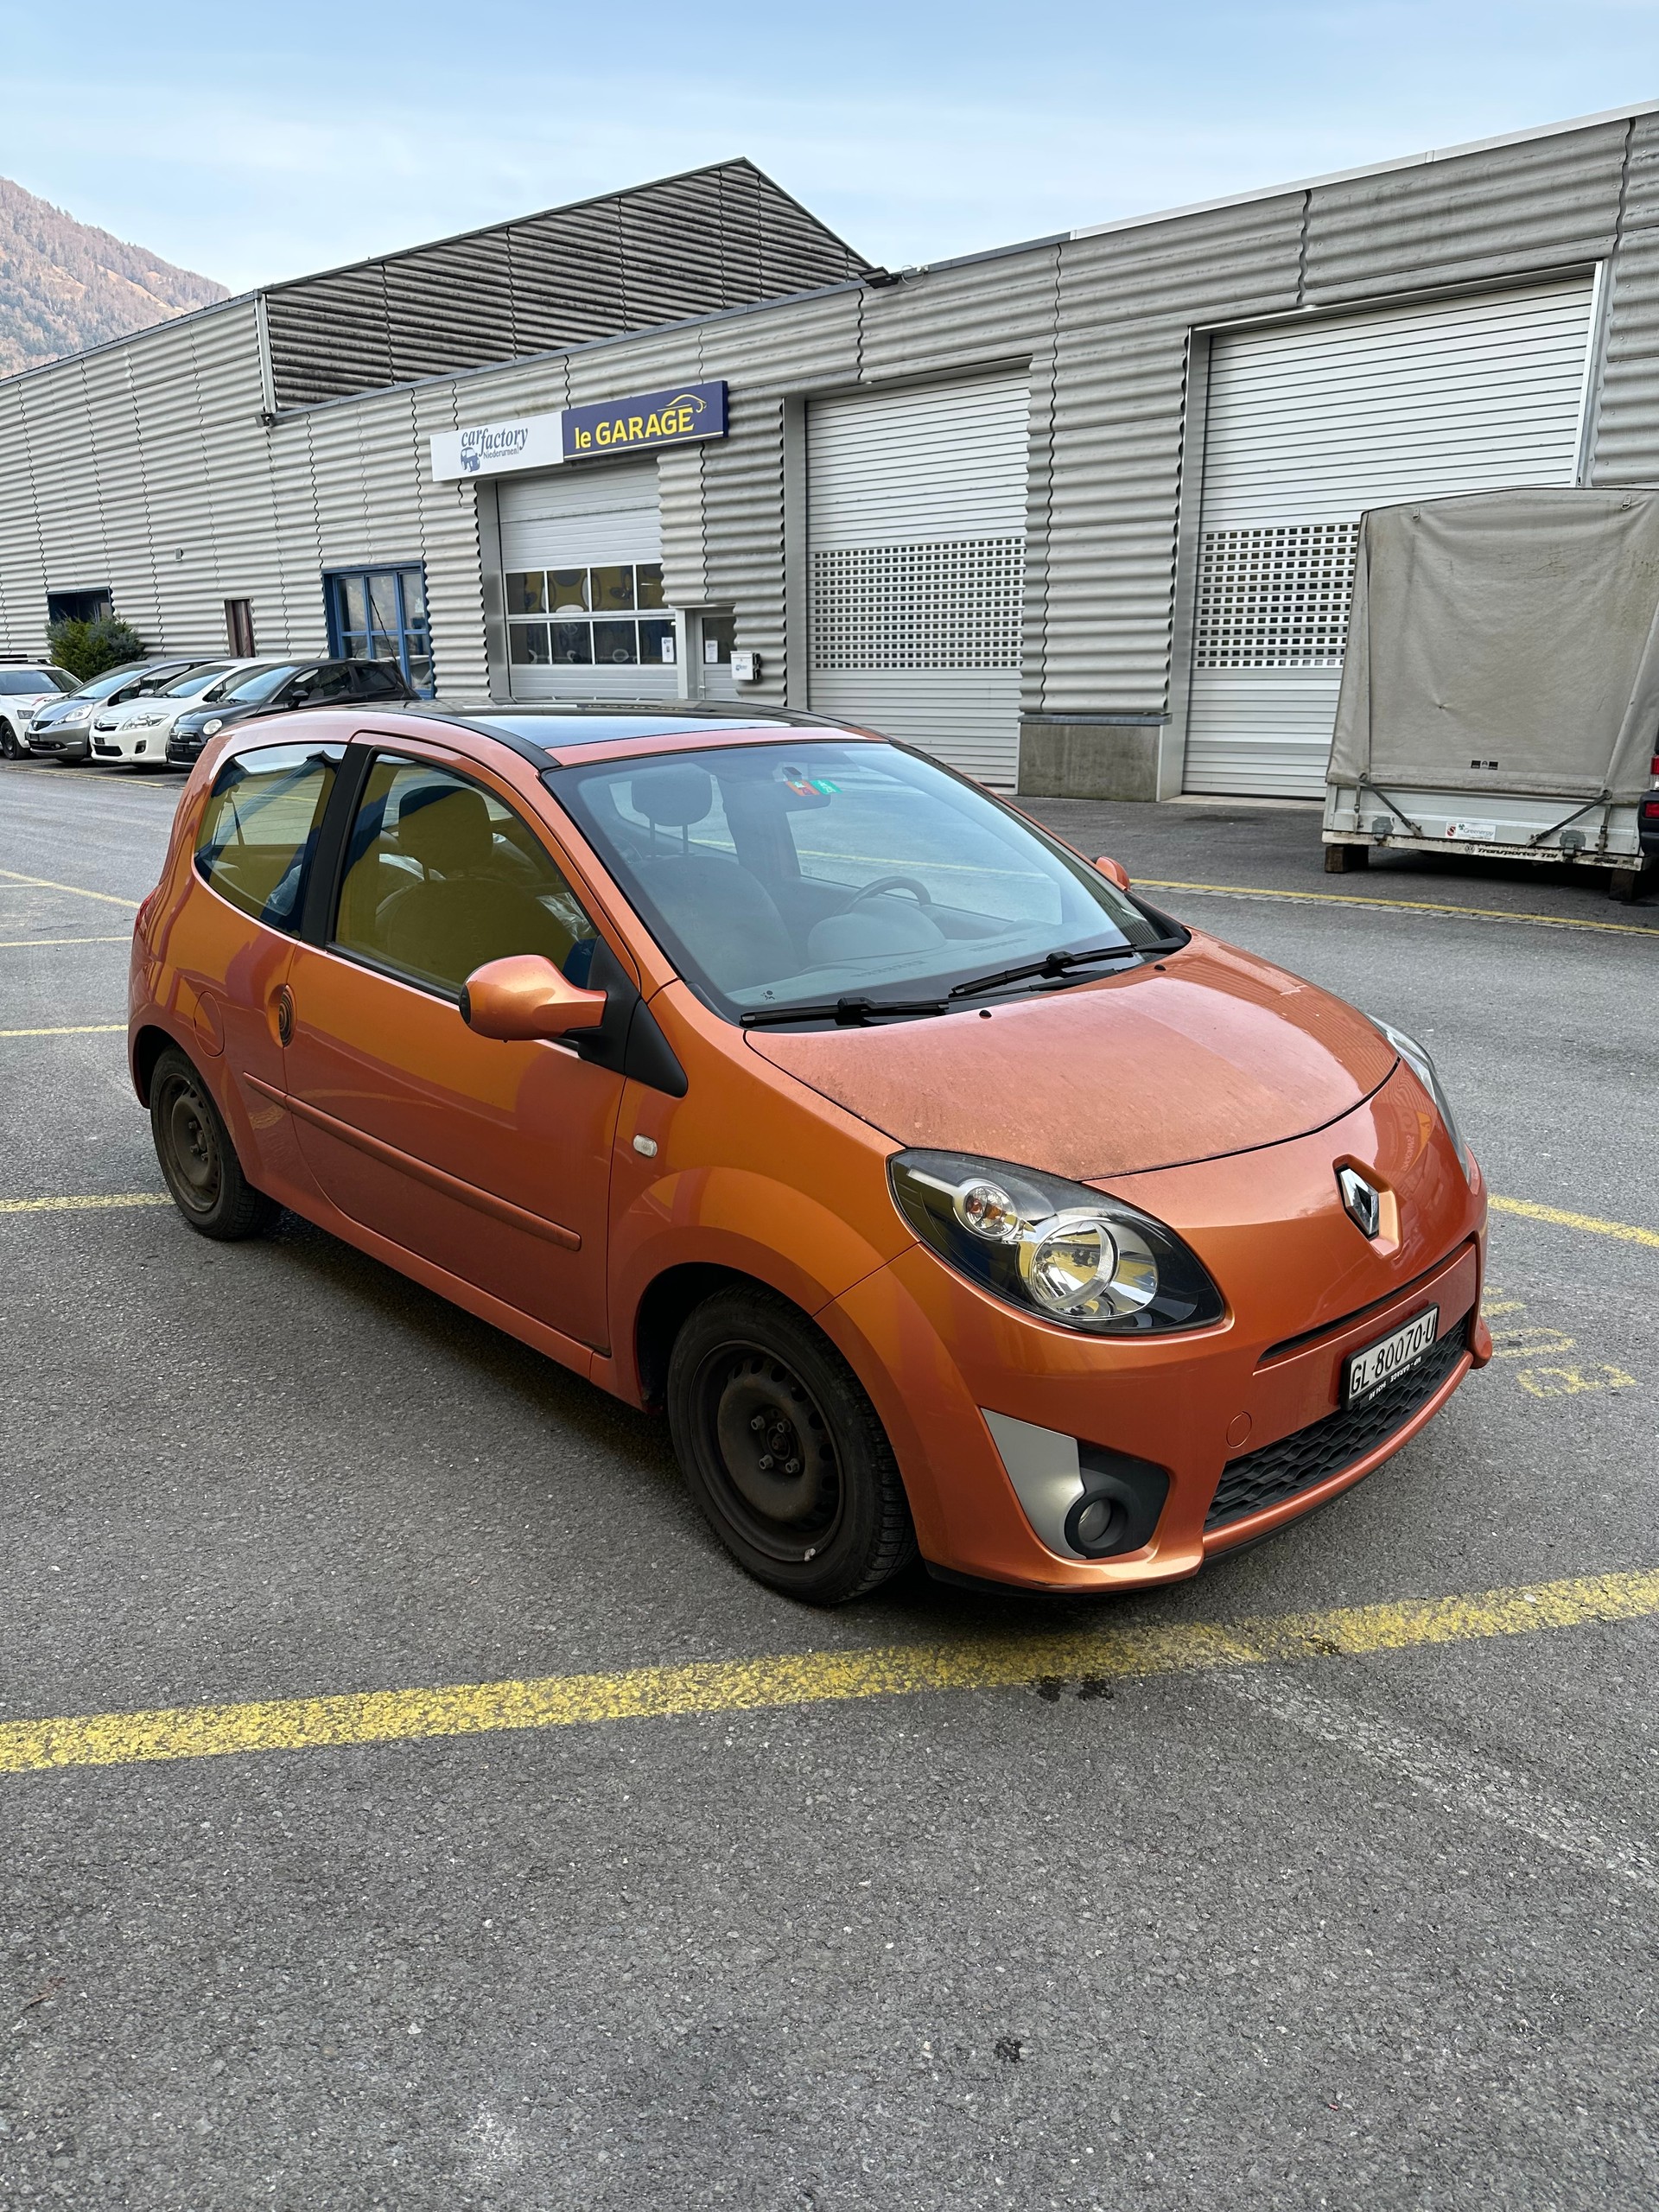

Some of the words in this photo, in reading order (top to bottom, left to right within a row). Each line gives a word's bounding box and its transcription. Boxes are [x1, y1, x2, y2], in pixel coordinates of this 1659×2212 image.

[574, 427, 592, 449] le
[595, 407, 695, 445] GARAGE
[1478, 848, 1539, 857] Transporter
